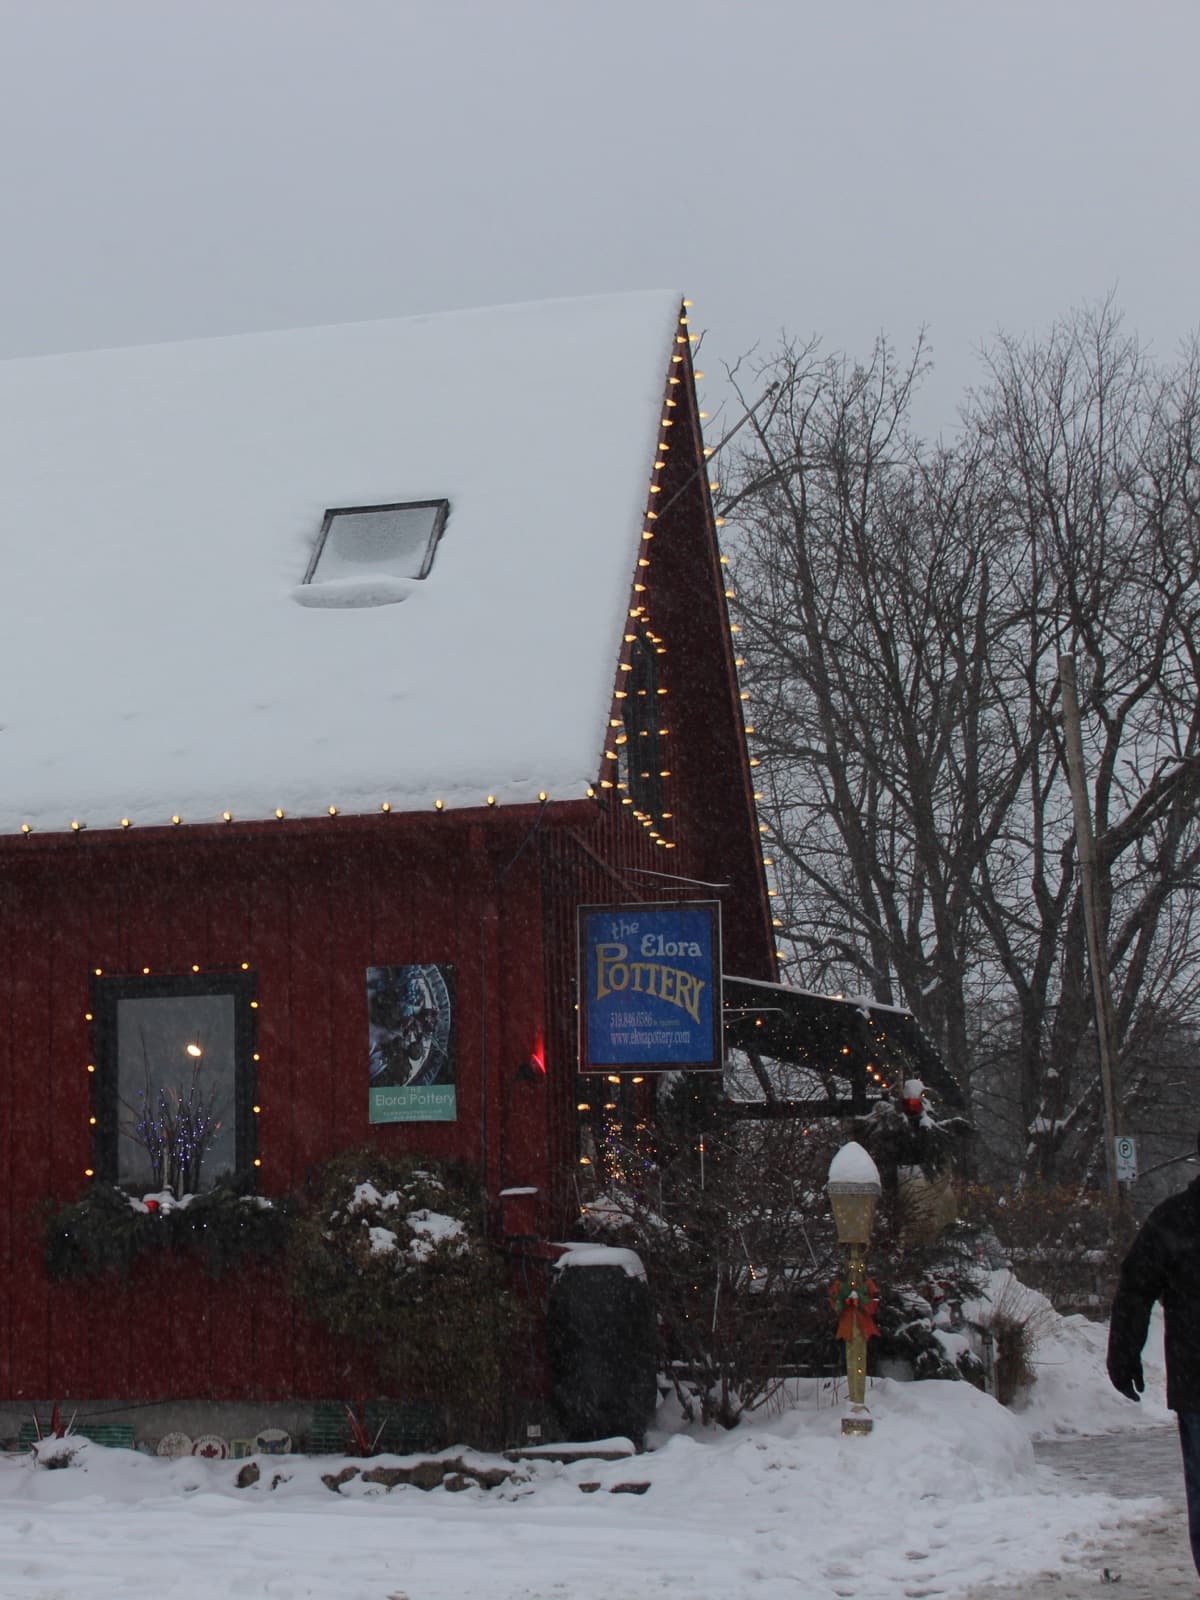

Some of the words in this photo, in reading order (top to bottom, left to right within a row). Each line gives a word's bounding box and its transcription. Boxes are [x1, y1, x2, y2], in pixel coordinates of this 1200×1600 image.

[611, 919, 640, 940] the
[640, 933, 702, 957] Elora
[595, 942, 705, 1025] POTTERY
[609, 1028, 690, 1048] www.elorapottery.com
[375, 1094, 407, 1106] Elora
[409, 1091, 455, 1106] Pottery
